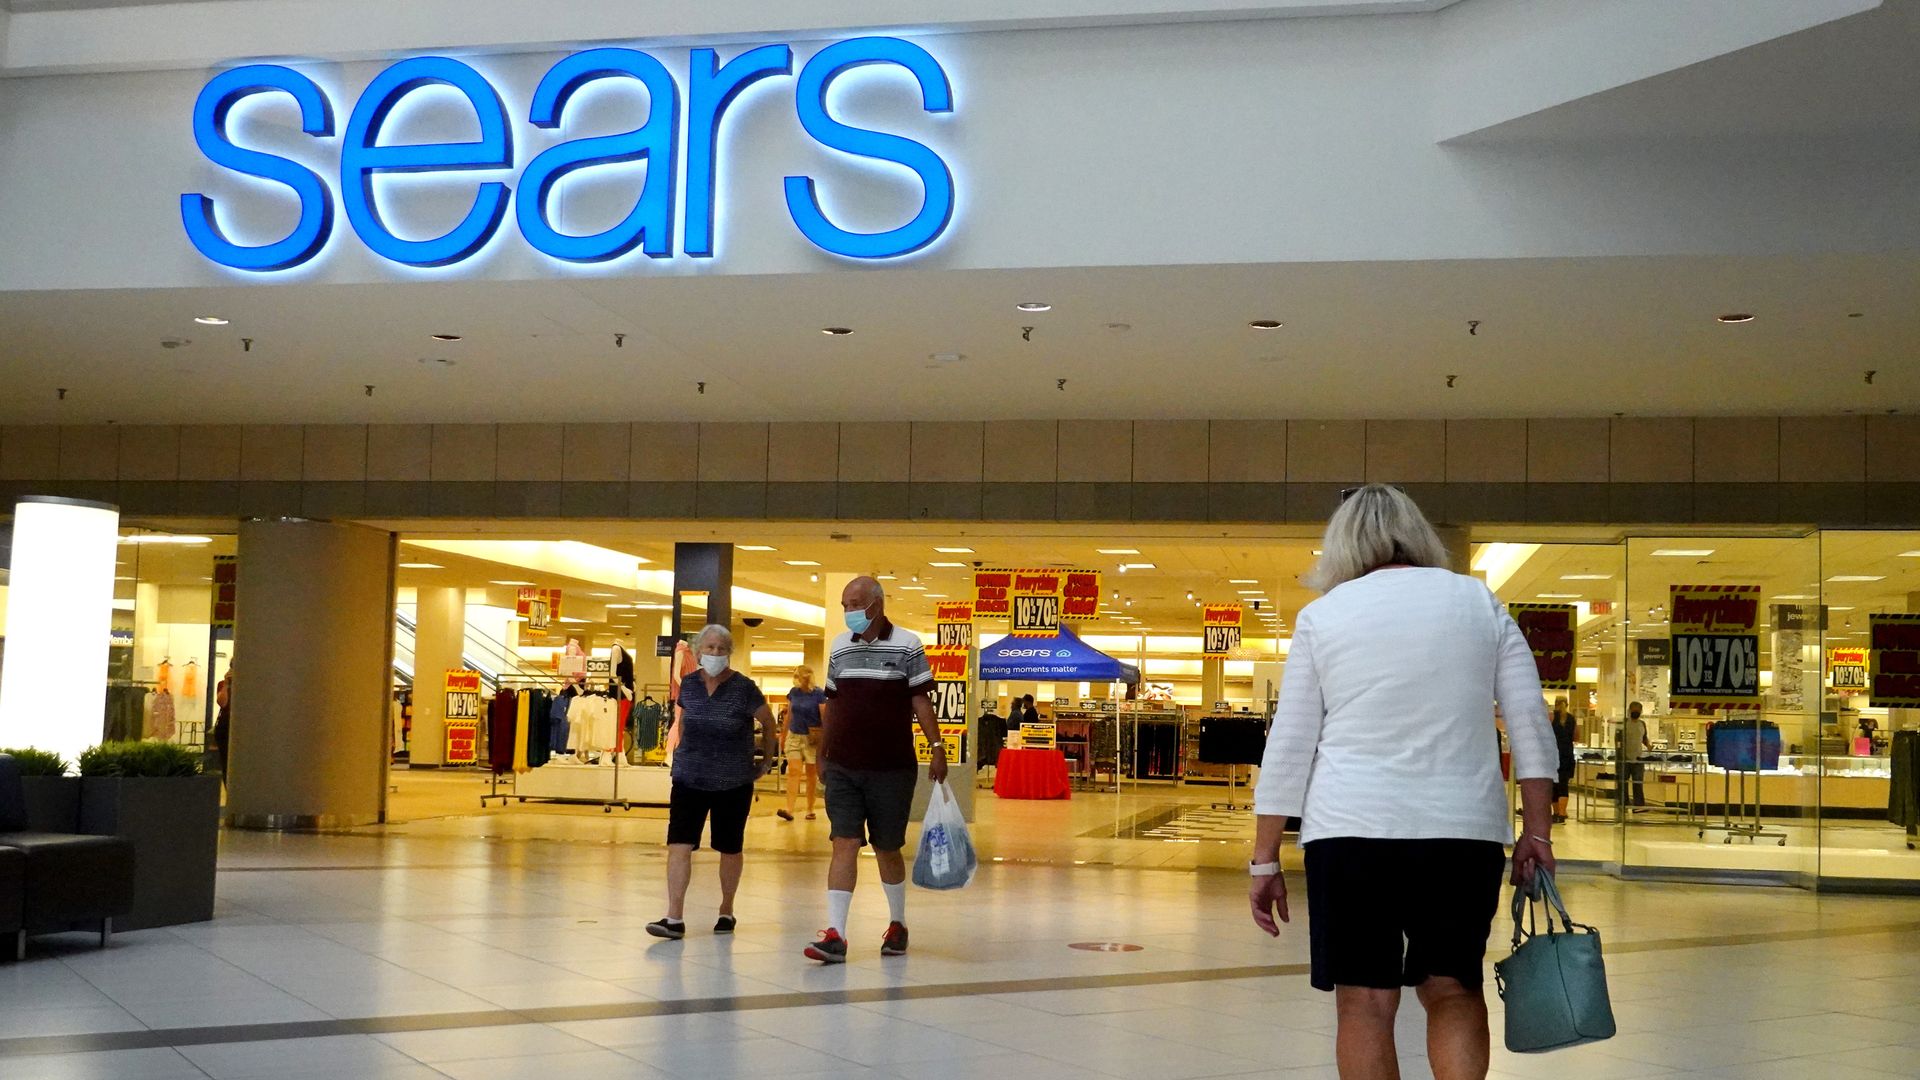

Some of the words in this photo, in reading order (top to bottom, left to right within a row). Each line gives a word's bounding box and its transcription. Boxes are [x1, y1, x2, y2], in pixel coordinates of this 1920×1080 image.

[181, 36, 956, 271] sears
[1672, 594, 1758, 630] Everything
[997, 648, 1051, 658] sears
[982, 666, 1011, 675] making
[1012, 665, 1050, 673] moments
[1051, 665, 1078, 673] matter
